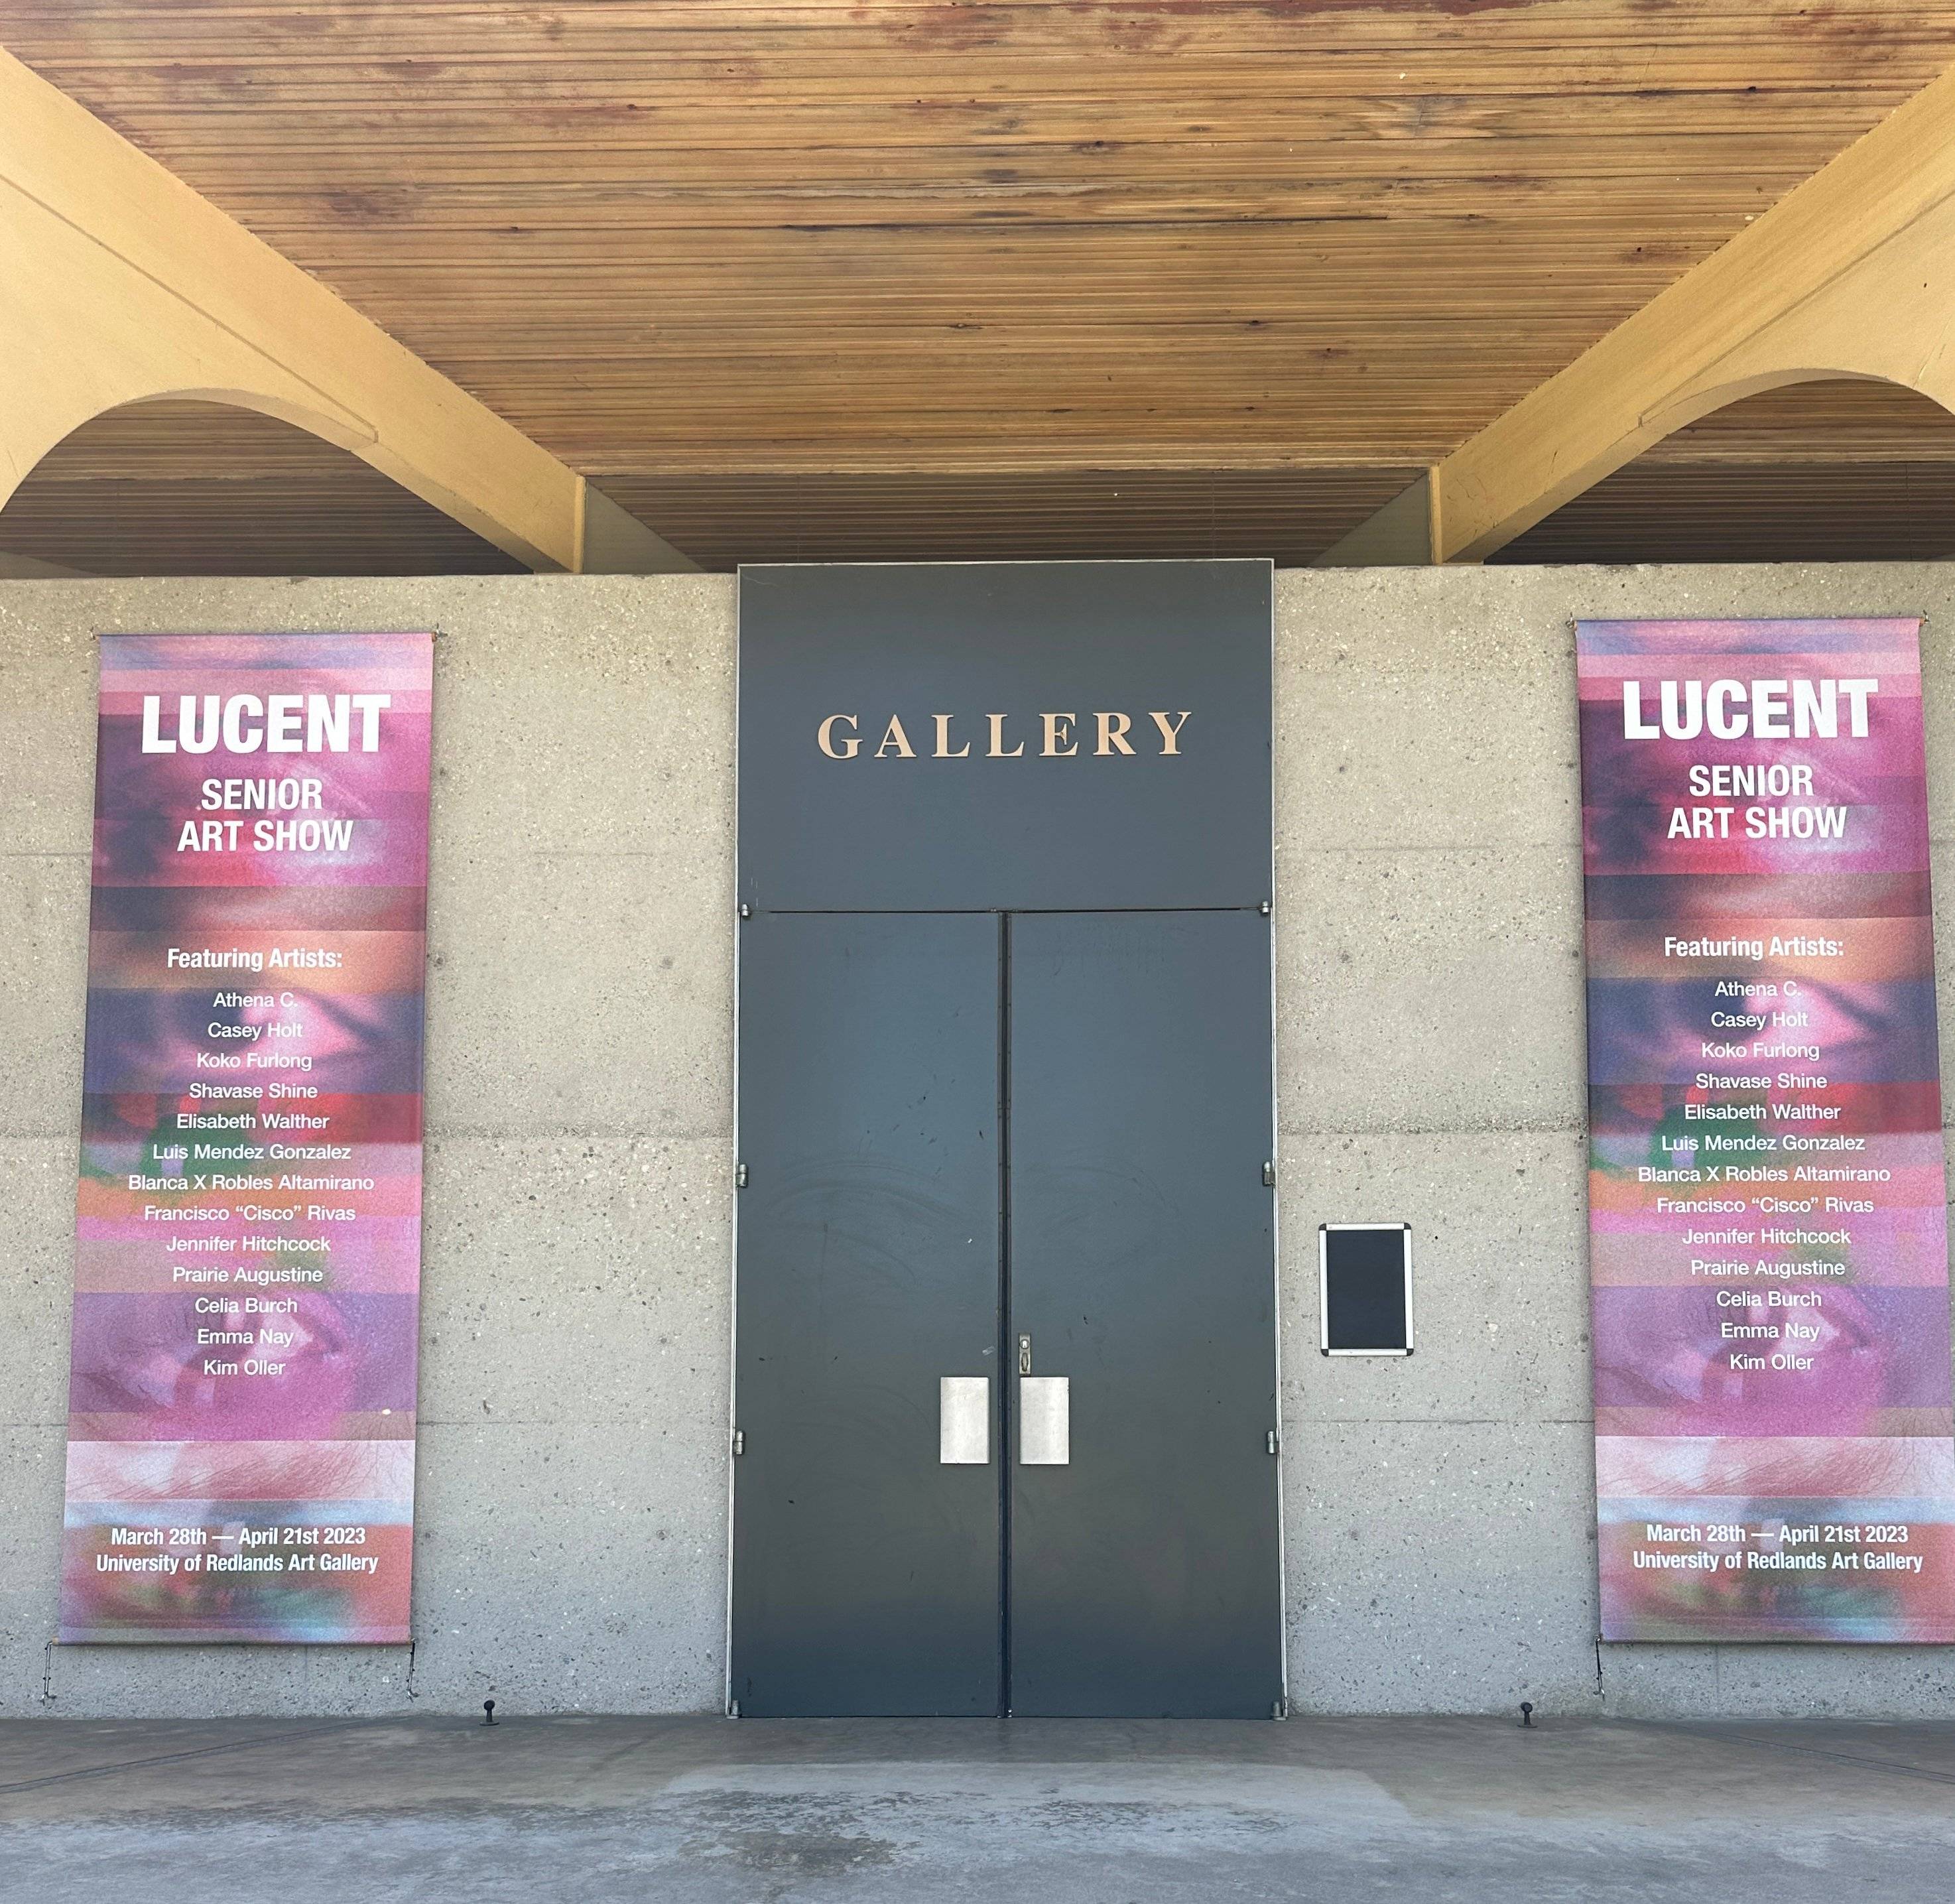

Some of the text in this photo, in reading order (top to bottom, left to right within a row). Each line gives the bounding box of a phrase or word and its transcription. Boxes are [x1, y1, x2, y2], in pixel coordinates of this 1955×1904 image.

[1623, 679, 1878, 739] LUCENT
[141, 695, 391, 754] LUCENT
[818, 711, 1192, 759] GALLERY
[1689, 765, 1814, 796] SENIOR
[201, 778, 323, 810] SENIOR
[1667, 807, 1846, 838] ART SHOW
[177, 820, 353, 852] ART SHOW
[1665, 936, 1844, 960] Featuring Artists:
[167, 947, 342, 972] Featuring Artists:
[1715, 981, 1802, 997] Athena C.
[213, 992, 298, 1008] Athena C.
[1711, 1012, 1808, 1031] Casey Holt
[208, 1023, 302, 1041] Casey Holt
[1702, 1043, 1820, 1061] Koko Furlong
[197, 1053, 312, 1072] Koko Furlong
[1696, 1073, 1828, 1089] Shavase Shine
[189, 1083, 318, 1099] Shavase Shine
[177, 1113, 329, 1129] Elisabeth Walther
[1685, 1104, 1841, 1121] Elisabeth Walther
[153, 1144, 351, 1160] Luis Mendez Gonzalez
[1662, 1135, 1865, 1151] Luis Mendez Gonzalez
[128, 1174, 374, 1191] Blanca X Robles Altamirano
[1638, 1166, 1891, 1182] Blanca X Robles Altamirano
[144, 1205, 355, 1222] Francisco “Cisco” Rivas
[1657, 1197, 1873, 1214] Francisco “Cisco” Rivas
[166, 1236, 331, 1252] Jennifer Hitchcock
[1682, 1228, 1851, 1245] Jennifer Hitchcock
[173, 1267, 323, 1286] Prairie Augustine
[1691, 1259, 1845, 1279] Prairie Augustine
[195, 1297, 298, 1313] Celia Burch
[1716, 1291, 1822, 1307] Celia Burch
[198, 1328, 293, 1348] Emma Nay
[1721, 1322, 1820, 1342] Emma Nay
[204, 1359, 286, 1375] Kim Oller
[1730, 1354, 1814, 1370] Kim Oller
[112, 1527, 164, 1545] March
[170, 1527, 206, 1545] 28th
[239, 1527, 279, 1549] April
[283, 1527, 320, 1545] 21st
[324, 1527, 366, 1545] 2023
[1646, 1525, 1701, 1543] March
[1706, 1525, 1745, 1543] 28th
[1779, 1525, 1820, 1547] April
[1824, 1525, 1860, 1543] 21st
[1865, 1525, 1908, 1543] 2023
[96, 1553, 379, 1574] University of Redlands Art Gallery
[1633, 1551, 1923, 1573] University of Redlands Art Gallery
